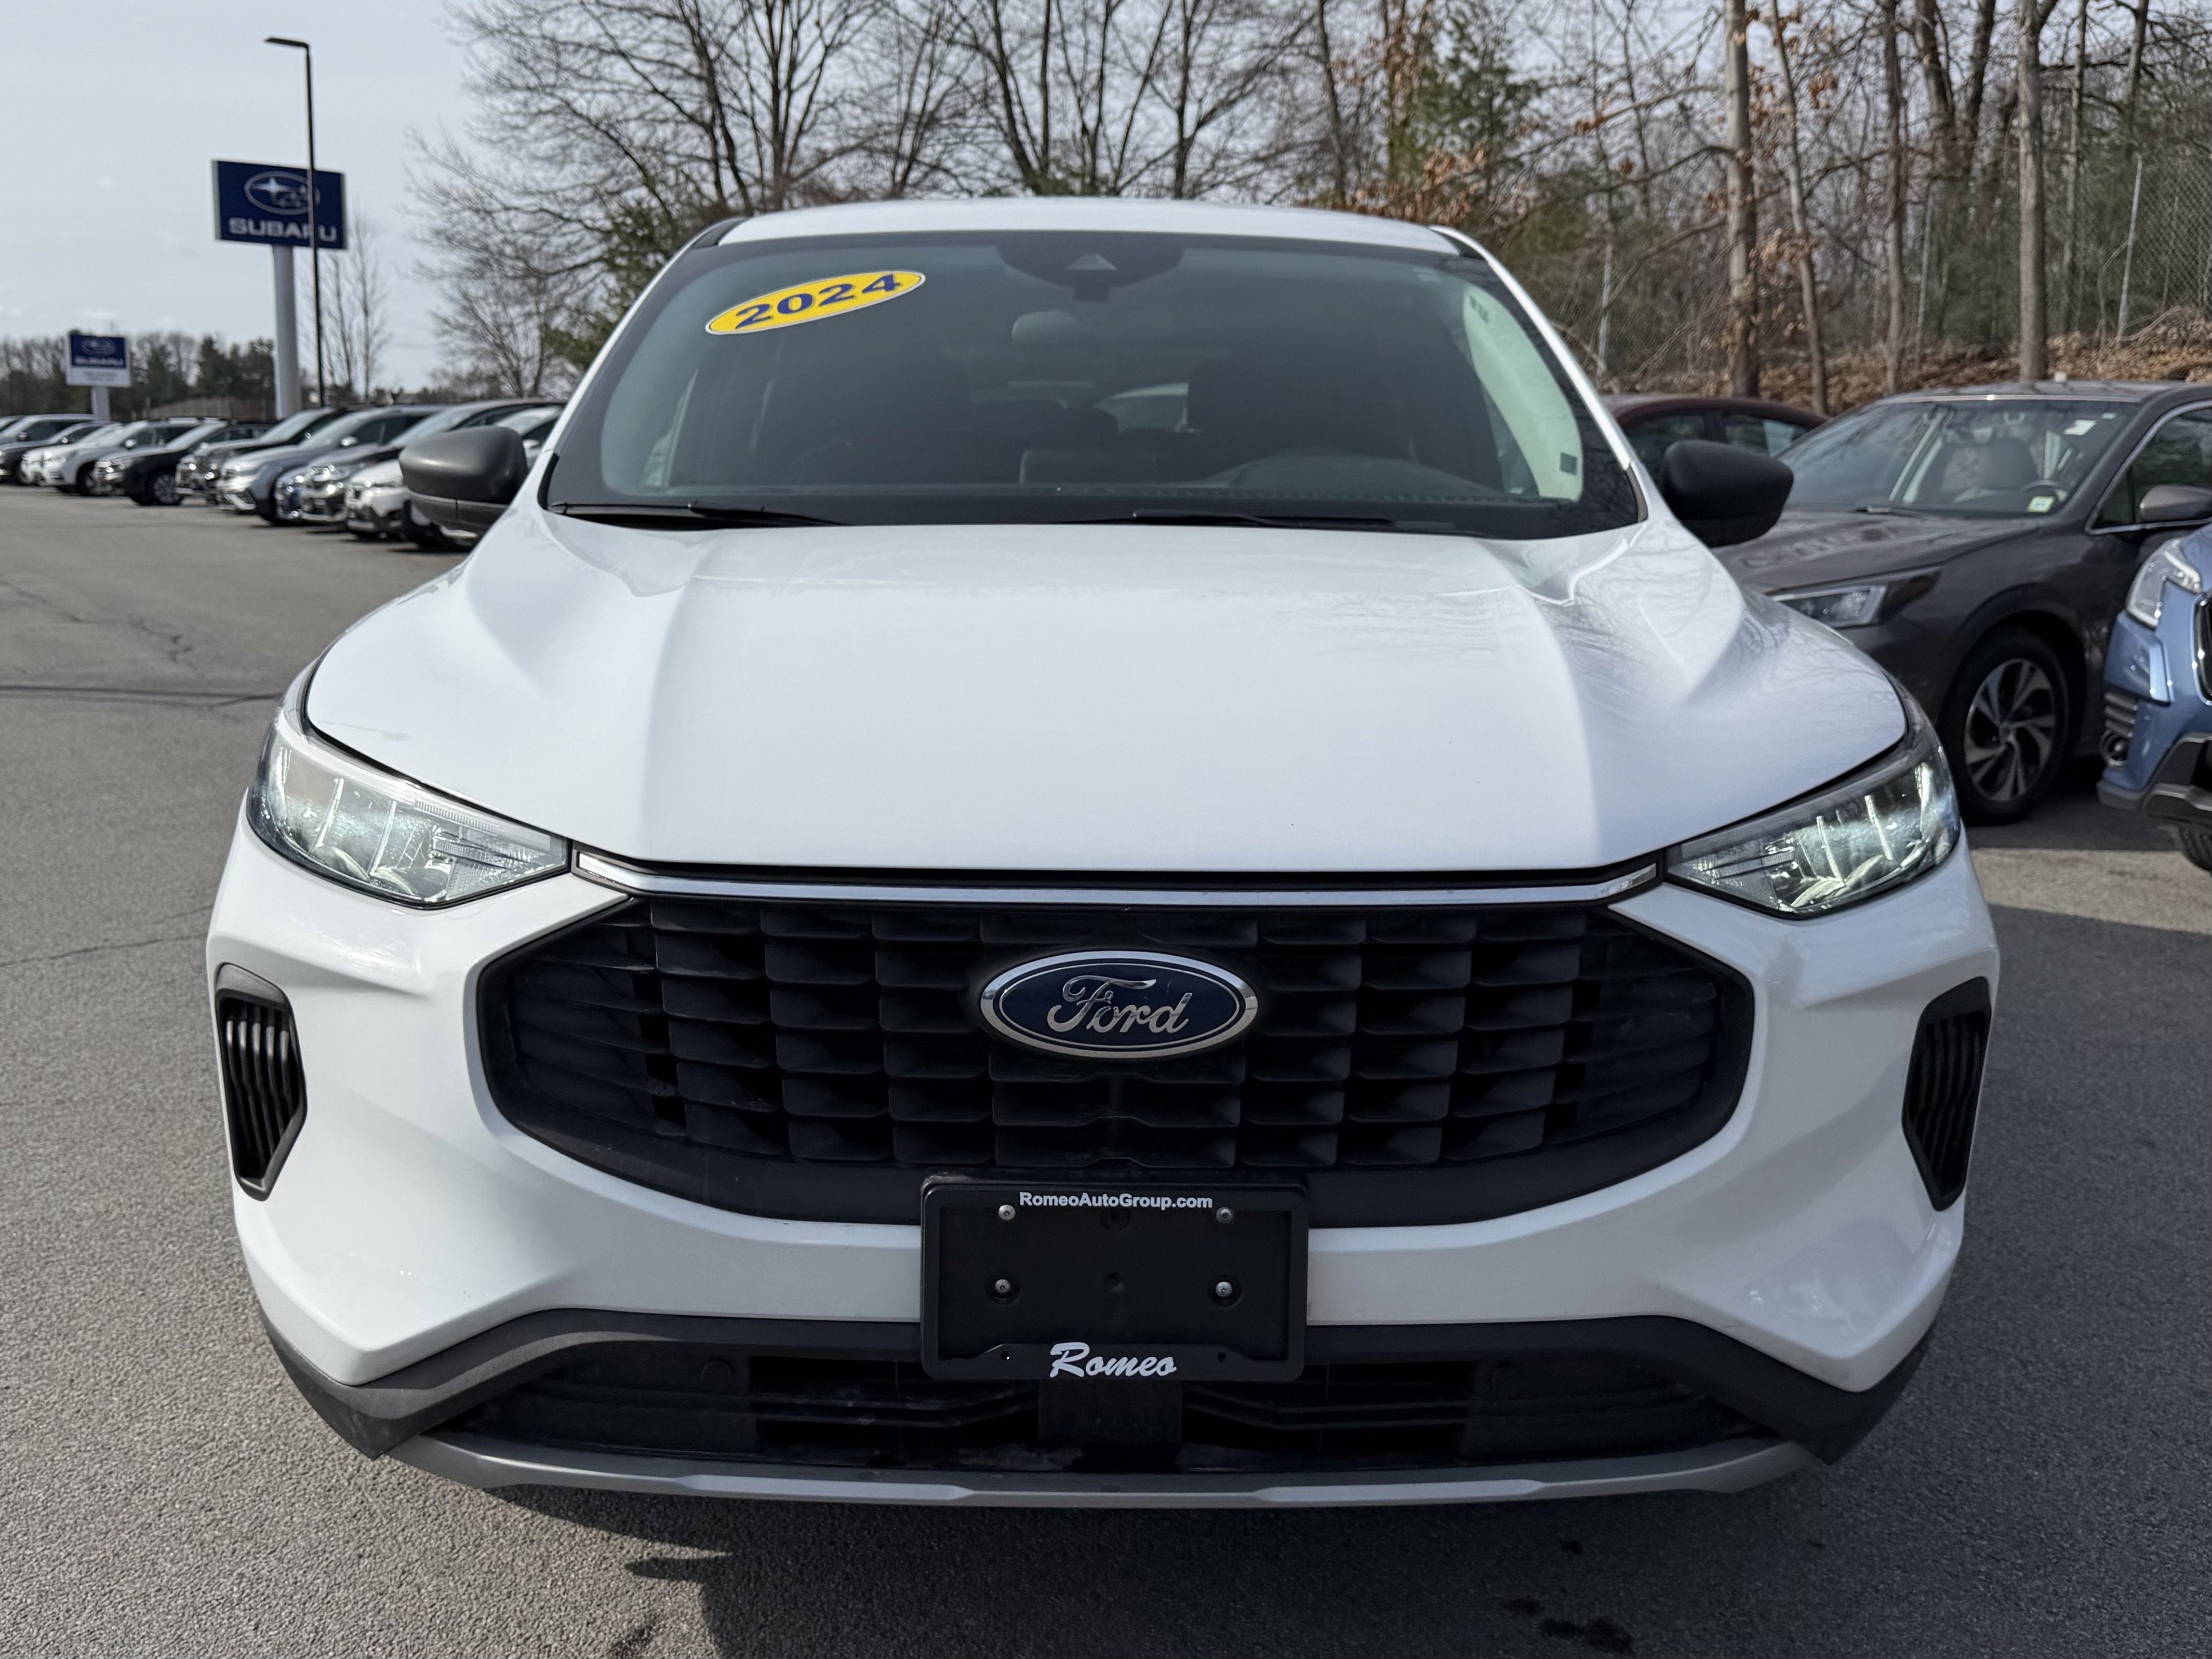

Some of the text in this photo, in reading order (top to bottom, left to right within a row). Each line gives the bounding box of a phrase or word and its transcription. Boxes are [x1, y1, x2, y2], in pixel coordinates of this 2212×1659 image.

[735, 274, 903, 329] 2024
[1047, 975, 1193, 1033] Ford
[1020, 1192, 1212, 1211] RomeoAutoGroup.com
[1049, 1342, 1177, 1378] Romeo
